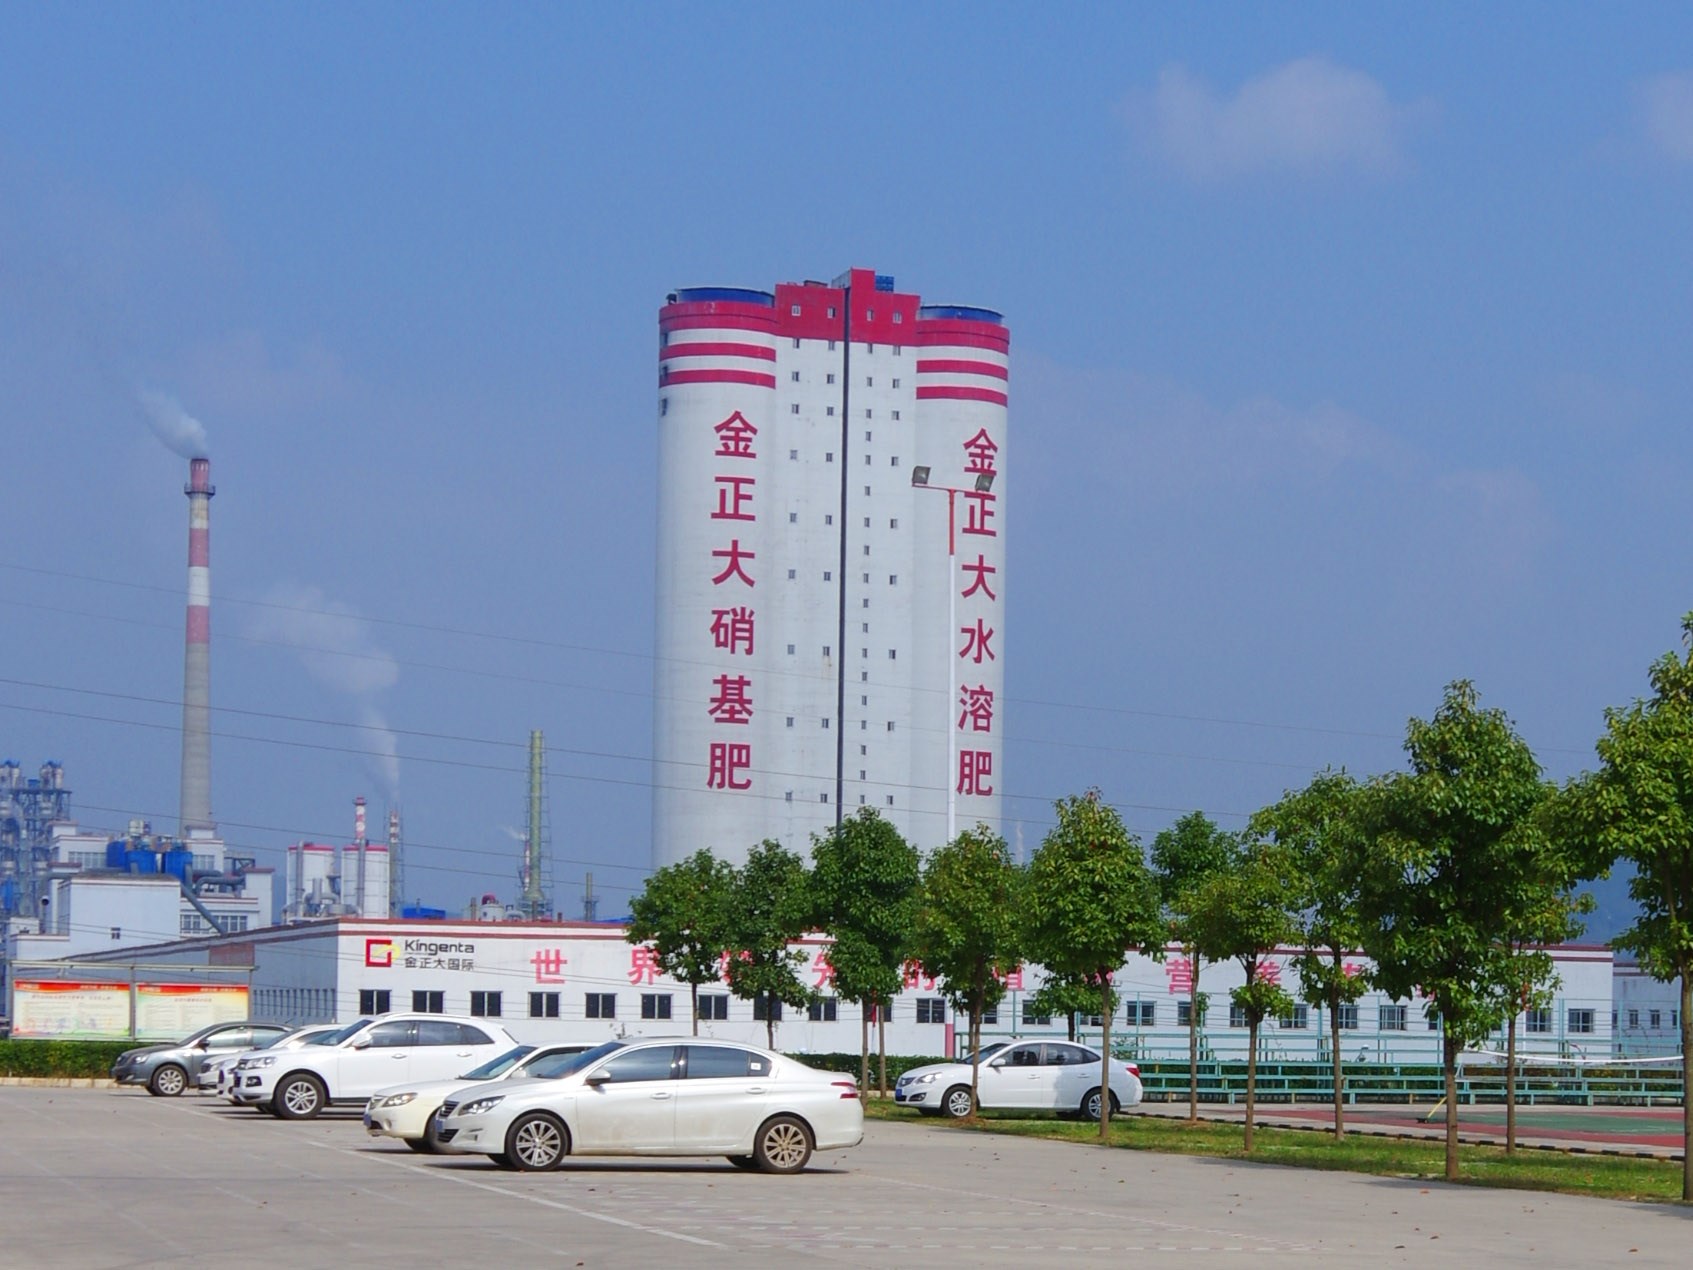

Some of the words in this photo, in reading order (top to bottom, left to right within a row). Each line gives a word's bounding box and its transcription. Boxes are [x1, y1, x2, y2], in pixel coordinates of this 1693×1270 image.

[707, 410, 758, 790] 金正大硝基肥
[956, 428, 999, 796] 金正大水溶肥
[404, 939, 475, 956] Kingenta
[404, 956, 475, 971] 金正大国际
